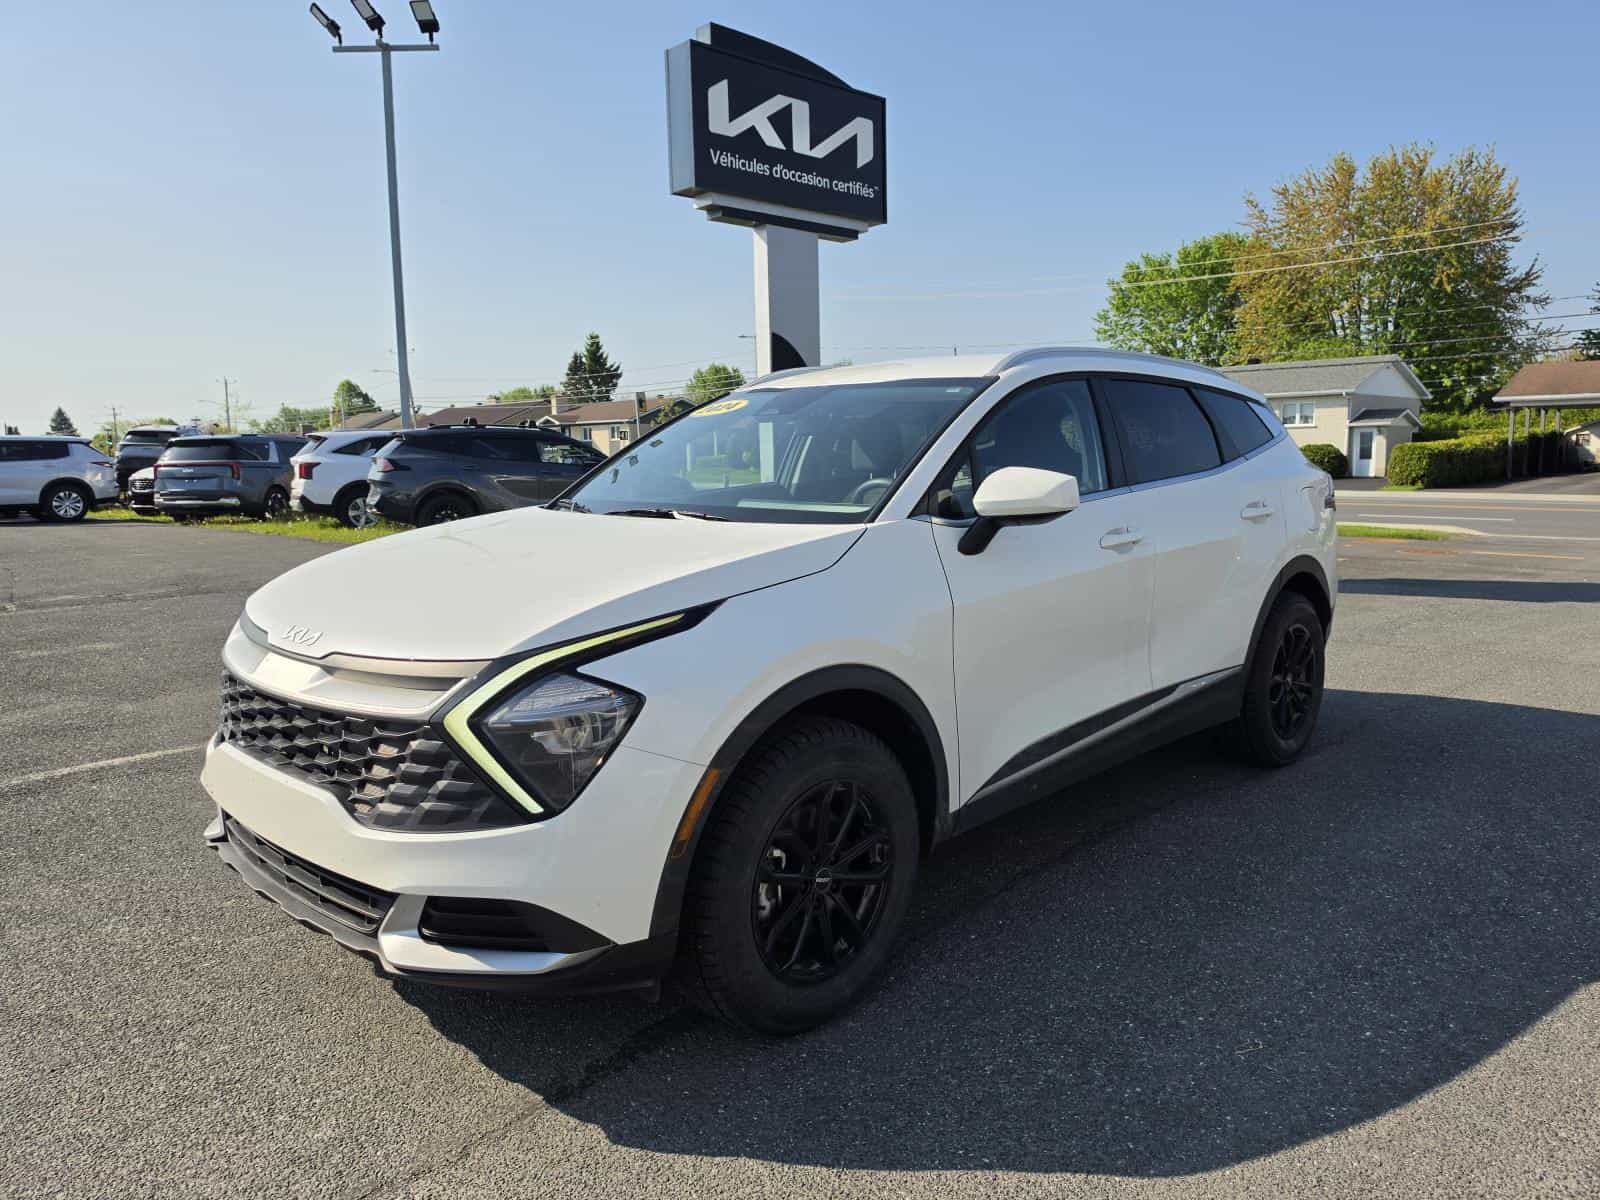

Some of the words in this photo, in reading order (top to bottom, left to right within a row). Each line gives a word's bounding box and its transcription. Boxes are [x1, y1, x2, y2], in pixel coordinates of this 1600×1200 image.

[707, 78, 874, 169] KIA
[709, 148, 770, 176] Véhicules
[281, 624, 325, 647] KIA
